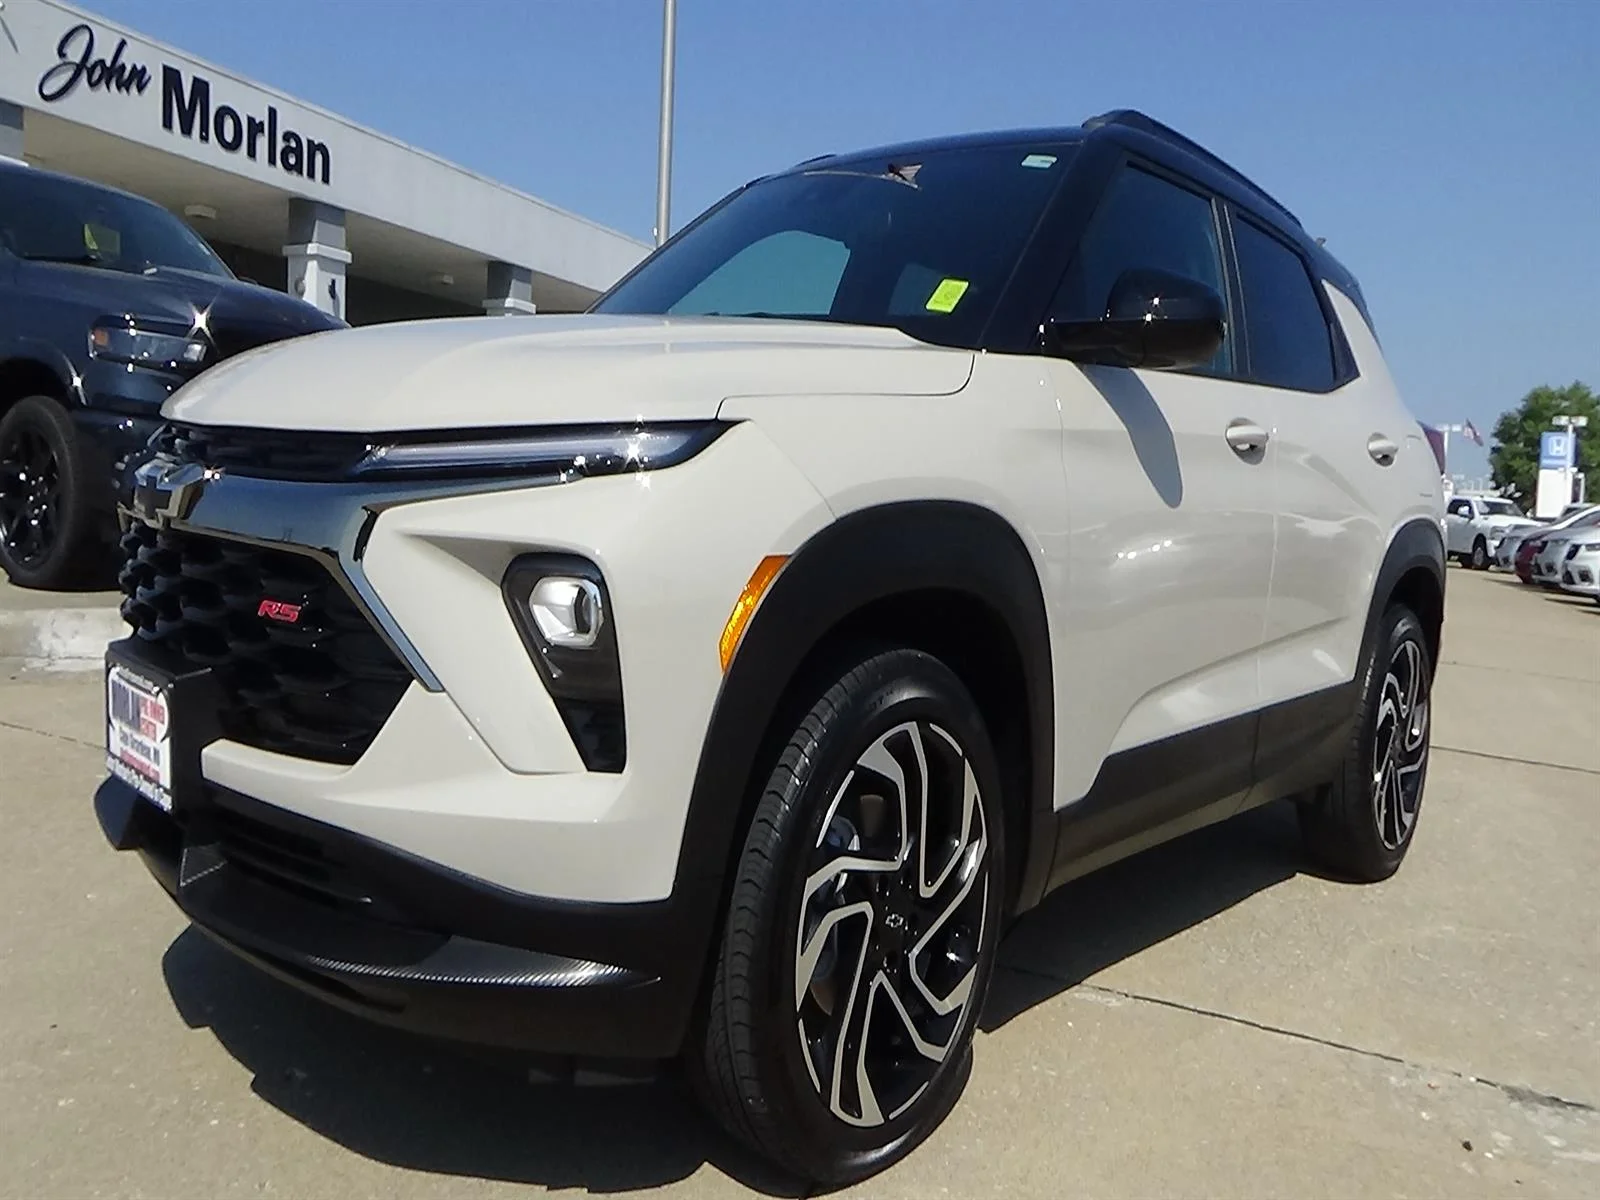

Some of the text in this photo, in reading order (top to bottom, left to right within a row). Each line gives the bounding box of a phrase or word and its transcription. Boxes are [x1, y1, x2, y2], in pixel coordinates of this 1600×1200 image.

[38, 23, 331, 186] John Morlan
[258, 599, 301, 622] RS
